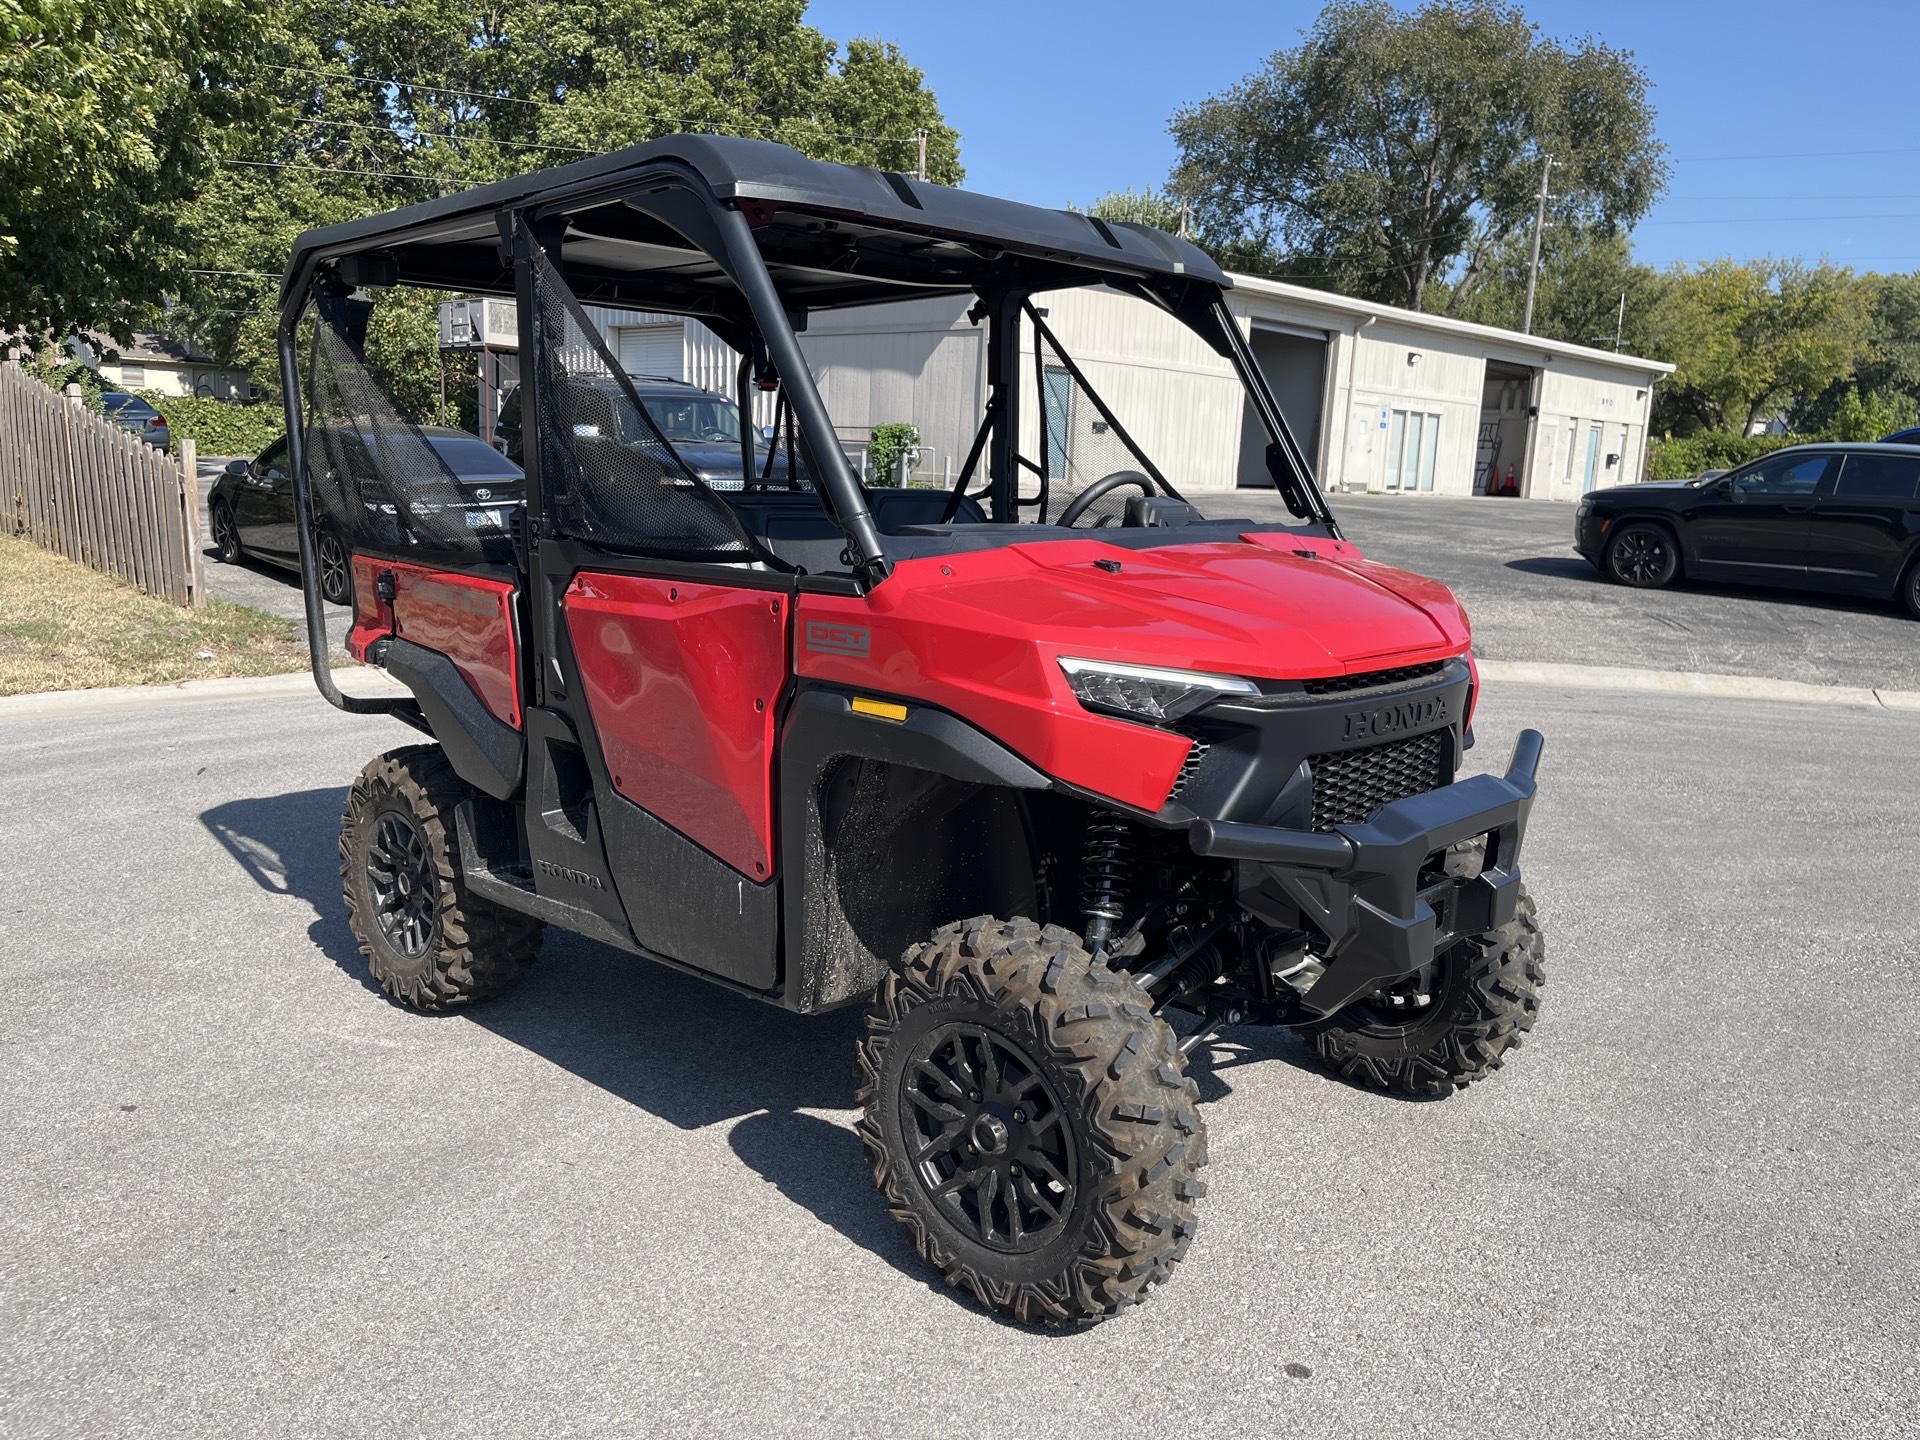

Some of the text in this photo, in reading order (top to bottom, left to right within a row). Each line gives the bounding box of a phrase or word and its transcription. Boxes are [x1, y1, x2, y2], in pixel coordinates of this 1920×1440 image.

[811, 626, 866, 645] DCT
[1342, 695, 1449, 742] HONDA
[537, 858, 607, 893] HONDA
